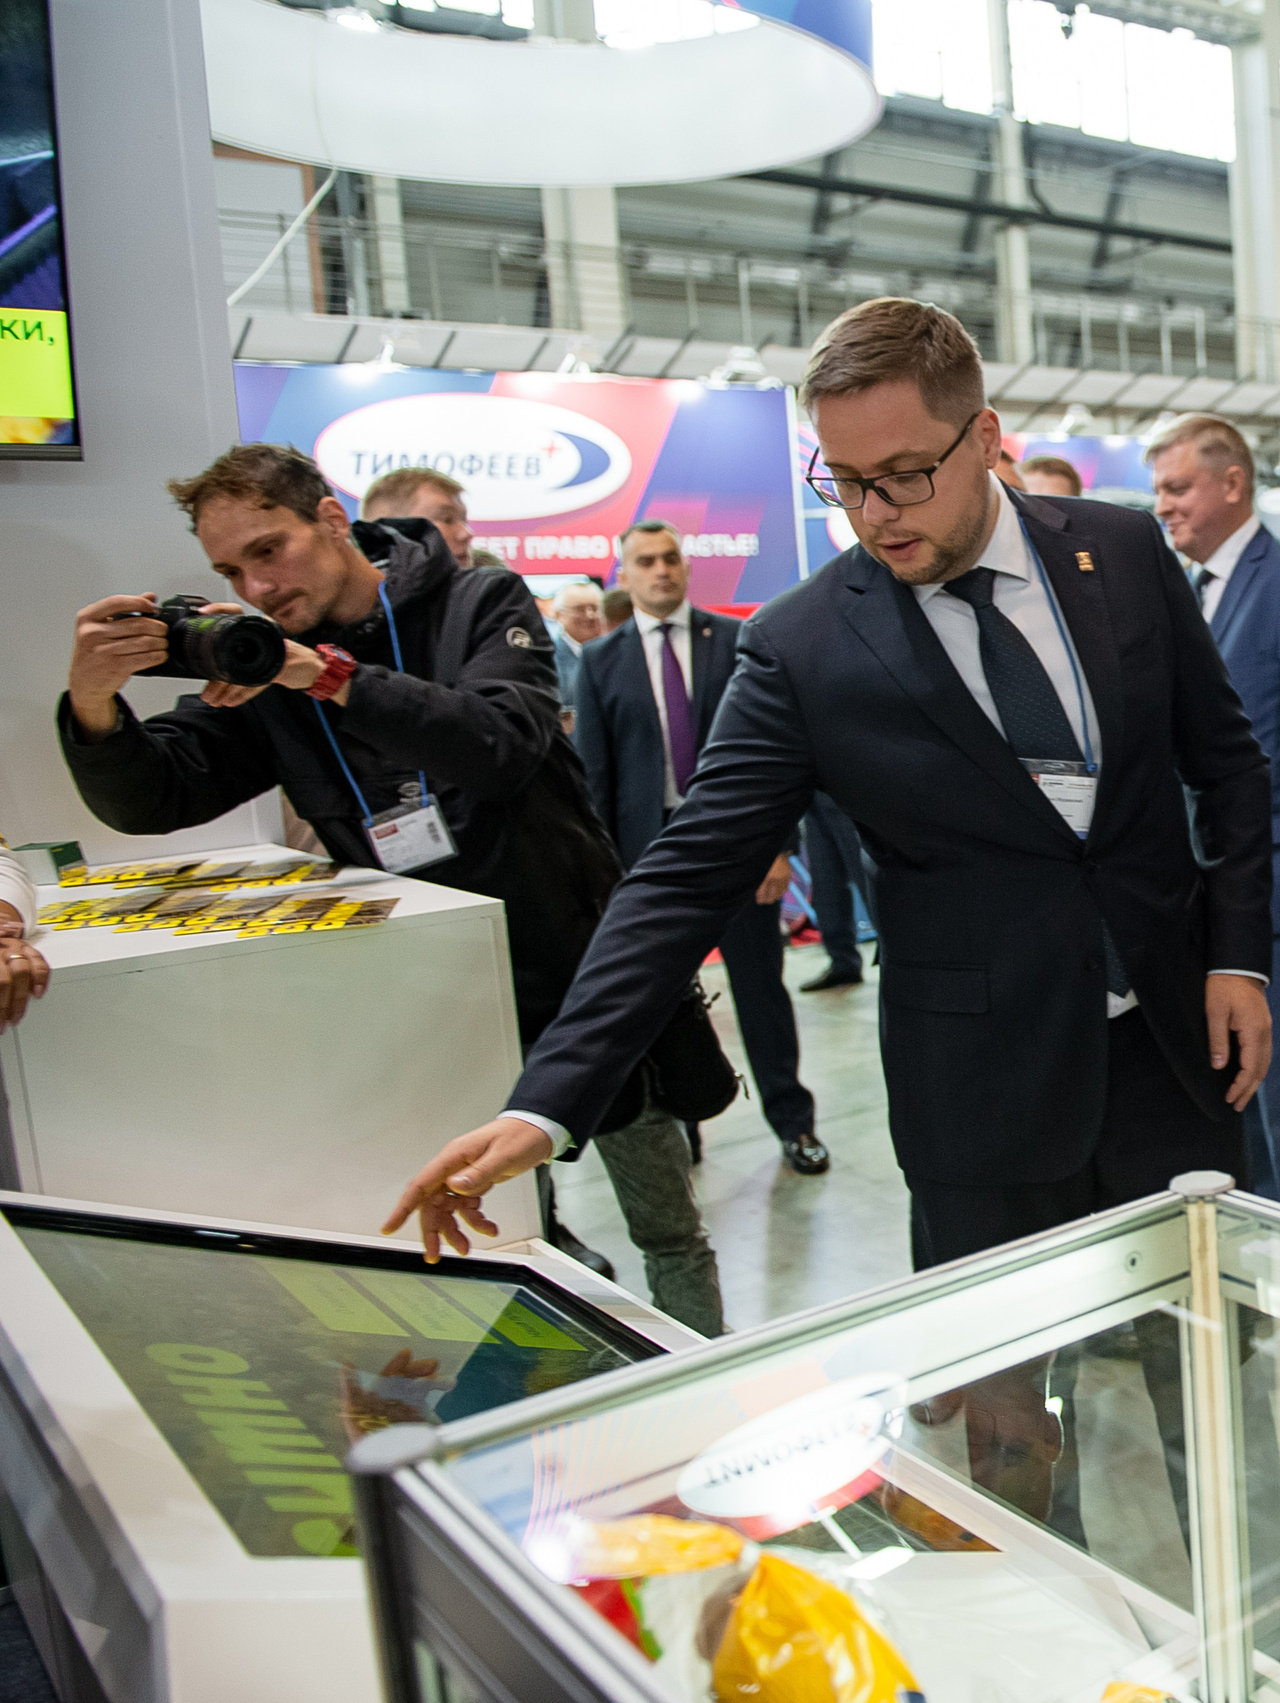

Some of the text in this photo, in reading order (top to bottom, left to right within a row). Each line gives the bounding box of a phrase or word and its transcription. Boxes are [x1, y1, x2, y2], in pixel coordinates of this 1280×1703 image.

[352, 450, 541, 477] ТИМОФЕЕВ
[470, 536, 521, 560] ЕЕТ
[523, 535, 610, 559] ПРАВО
[681, 533, 759, 557] АСТЬЕ!
